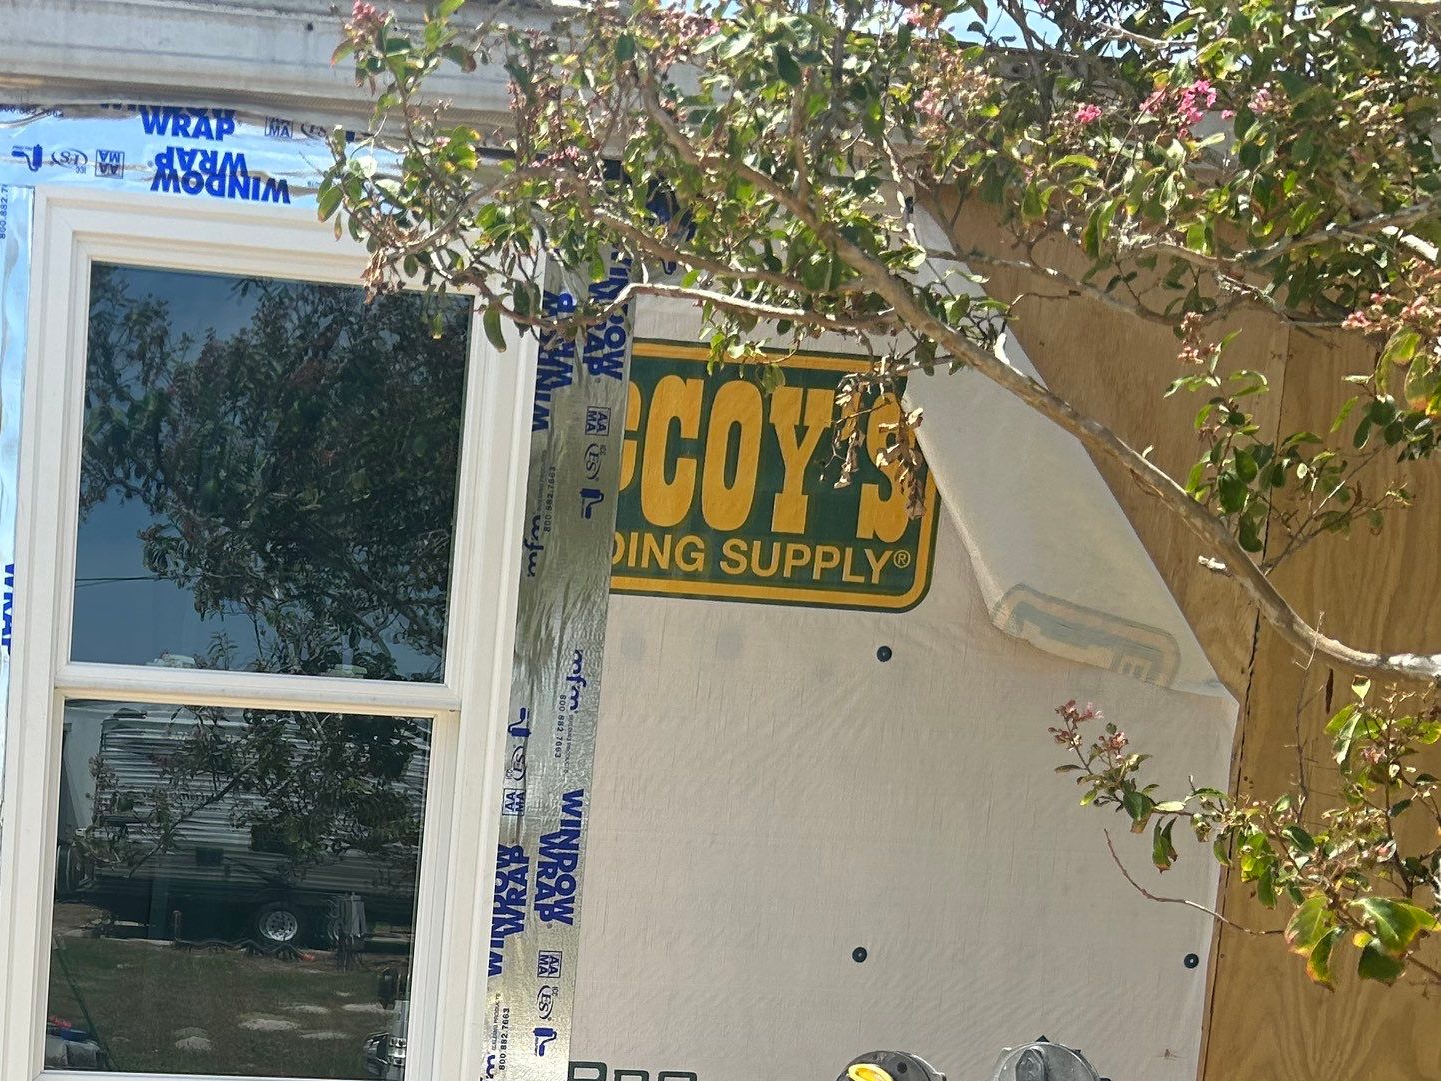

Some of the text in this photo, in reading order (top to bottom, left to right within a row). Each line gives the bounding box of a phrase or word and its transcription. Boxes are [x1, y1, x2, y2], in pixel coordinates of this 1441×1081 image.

[140, 106, 236, 140] WRAP
[98, 163, 119, 175] AA
[99, 151, 120, 163] MA
[155, 146, 249, 178] WRAP
[150, 168, 291, 204] WINDOW
[582, 280, 610, 376] WAP
[603, 250, 635, 381] WINOW
[586, 409, 597, 433] MA
[597, 410, 607, 433] AA
[523, 514, 544, 578] mfm
[565, 650, 587, 711] mfm
[504, 790, 516, 813] AA
[553, 788, 585, 926] WINDOW
[503, 844, 530, 938] WRAP
[533, 830, 563, 924] WRAP
[487, 842, 511, 977] WINDOW
[538, 954, 549, 976] MA
[548, 954, 560, 976] AA
